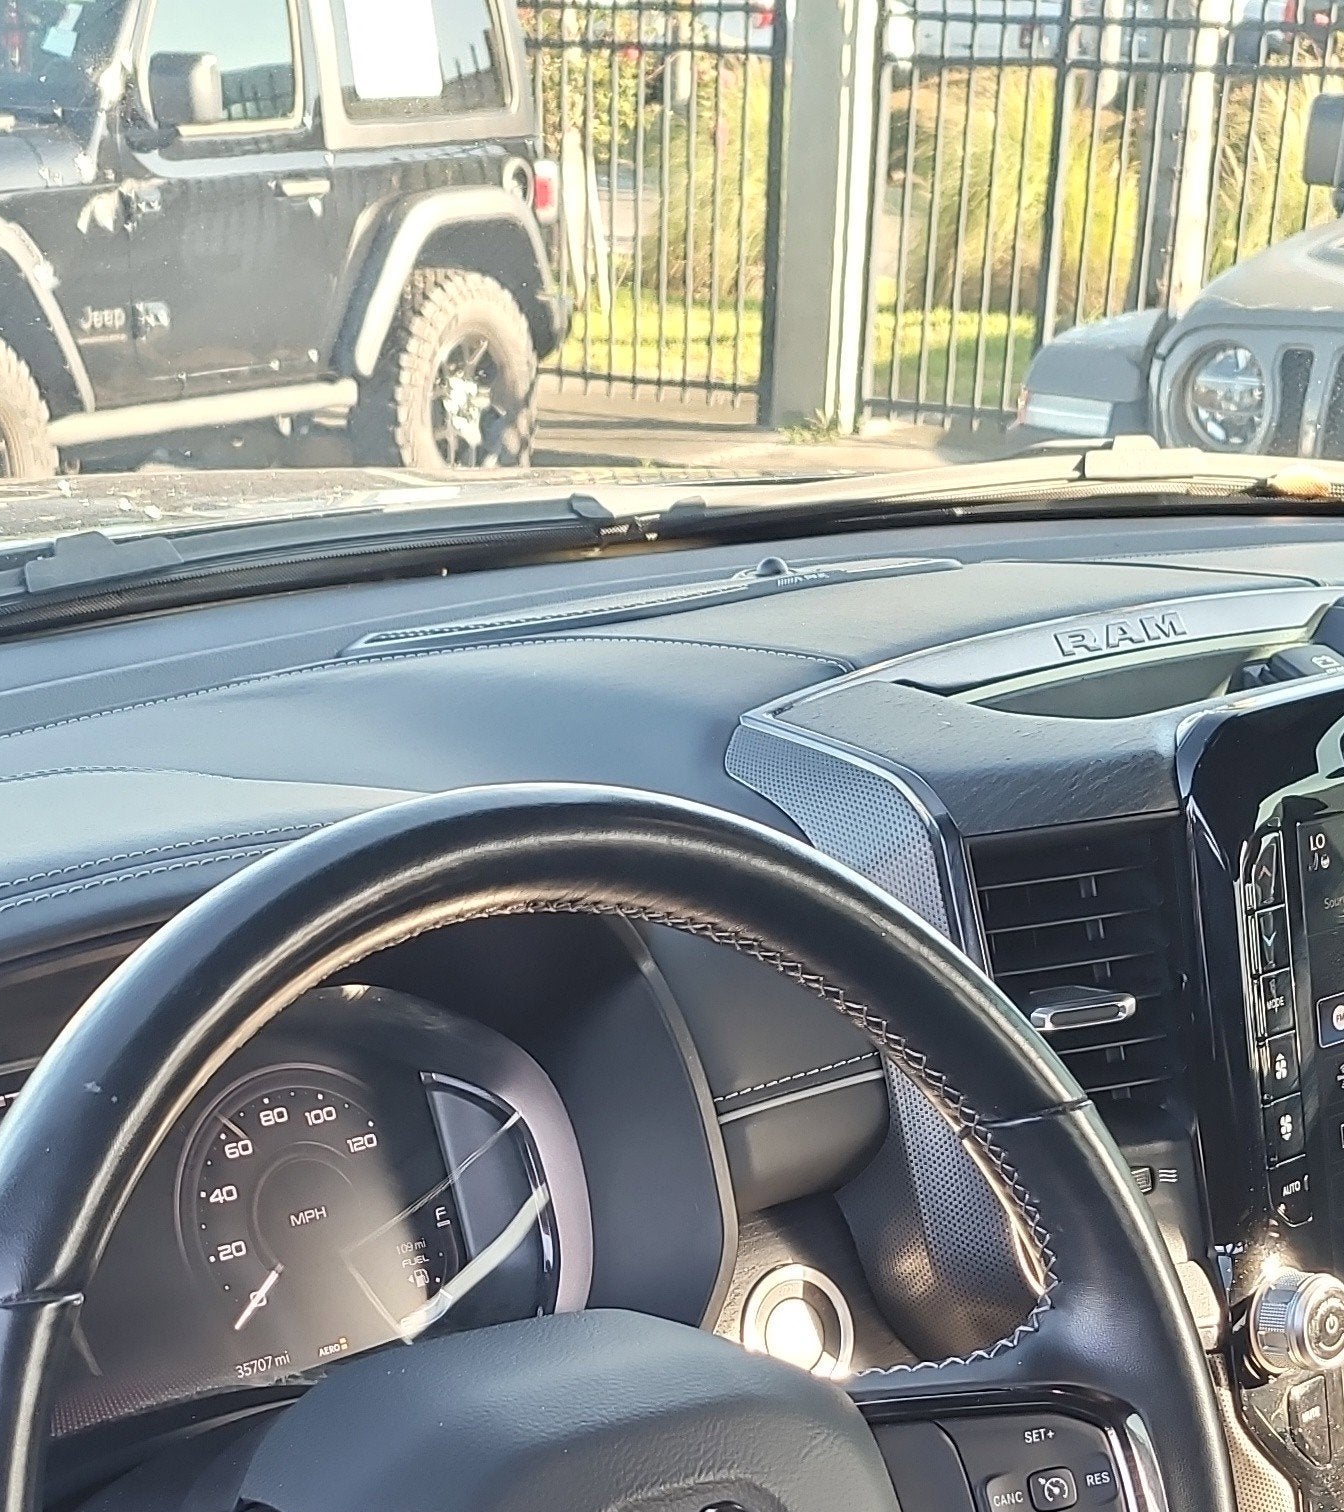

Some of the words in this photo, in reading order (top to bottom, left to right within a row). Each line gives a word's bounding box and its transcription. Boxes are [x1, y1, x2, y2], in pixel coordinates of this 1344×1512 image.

[80, 306, 126, 332] Jeep
[1053, 611, 1187, 657] RAM
[1309, 833, 1326, 852] LO
[259, 1107, 288, 1127] 80
[305, 1106, 337, 1126] 100
[224, 1139, 253, 1159] 60
[347, 1133, 378, 1153] 120
[209, 1185, 238, 1204] 40
[1282, 1180, 1301, 1197] AUTO
[289, 1206, 327, 1227] MPH
[435, 1206, 447, 1221] F
[218, 1240, 247, 1261] 20
[415, 1237, 427, 1250] mi
[402, 1255, 430, 1269] FUEL
[318, 1342, 341, 1358] AERO
[235, 1354, 274, 1379] 35707
[274, 1350, 291, 1367] mi
[1085, 1471, 1111, 1487] RES
[992, 1489, 1024, 1507] CANC
